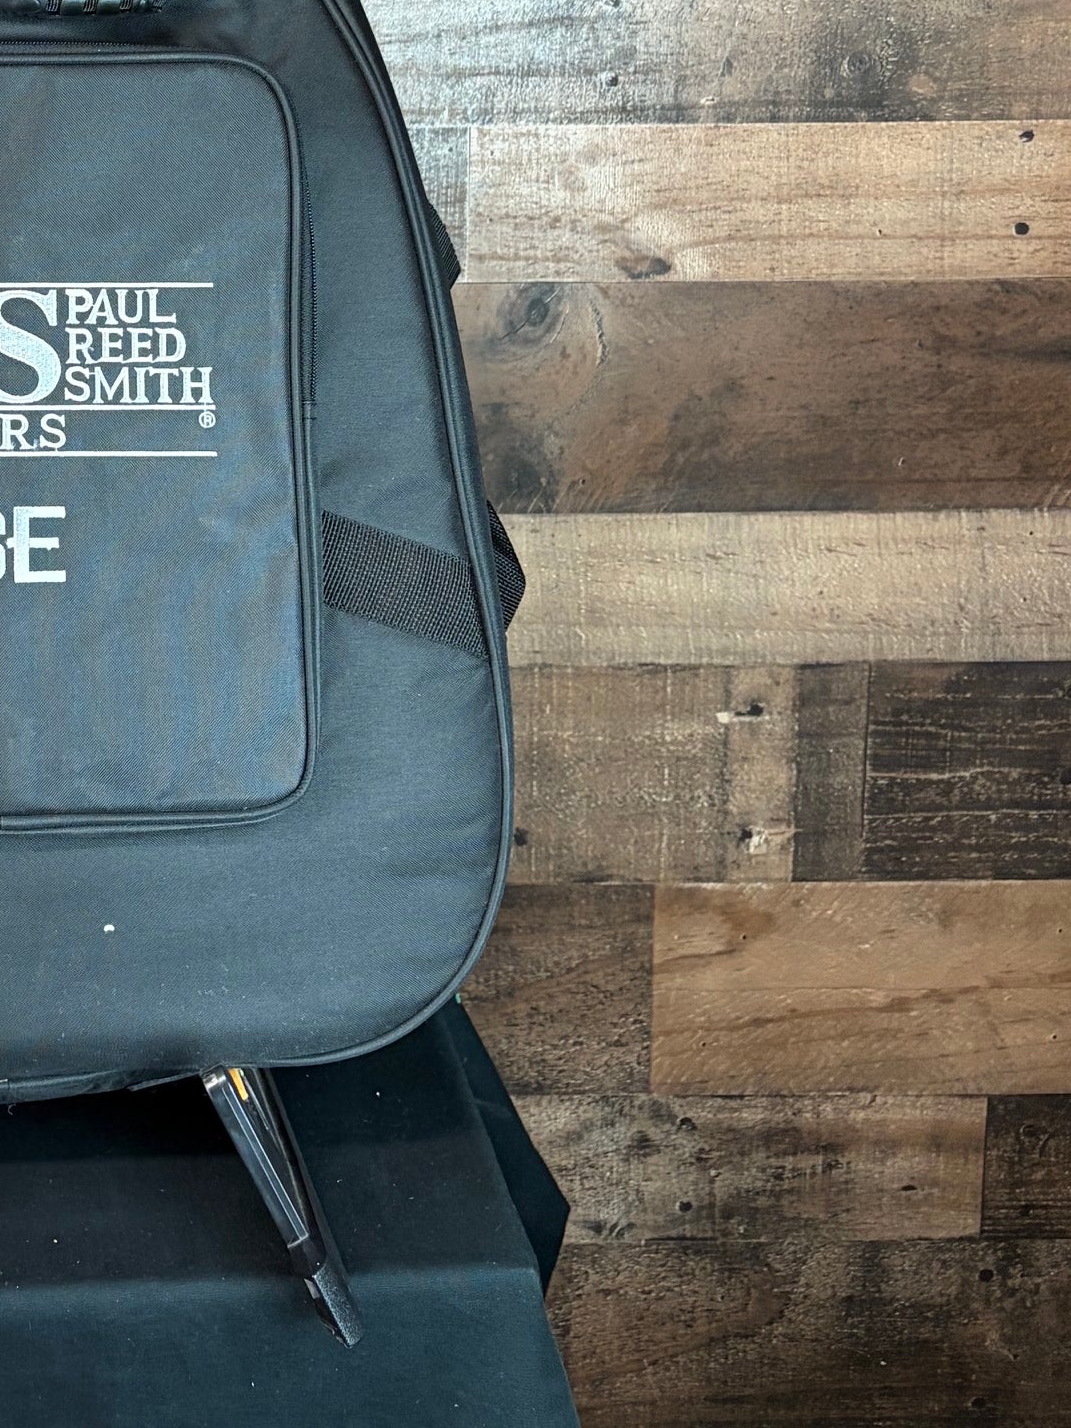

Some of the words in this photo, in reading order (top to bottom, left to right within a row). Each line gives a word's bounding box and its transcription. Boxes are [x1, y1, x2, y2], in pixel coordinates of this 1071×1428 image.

[64, 289, 177, 325] PAUL
[64, 328, 187, 364] REED
[64, 366, 214, 404] SMITH
